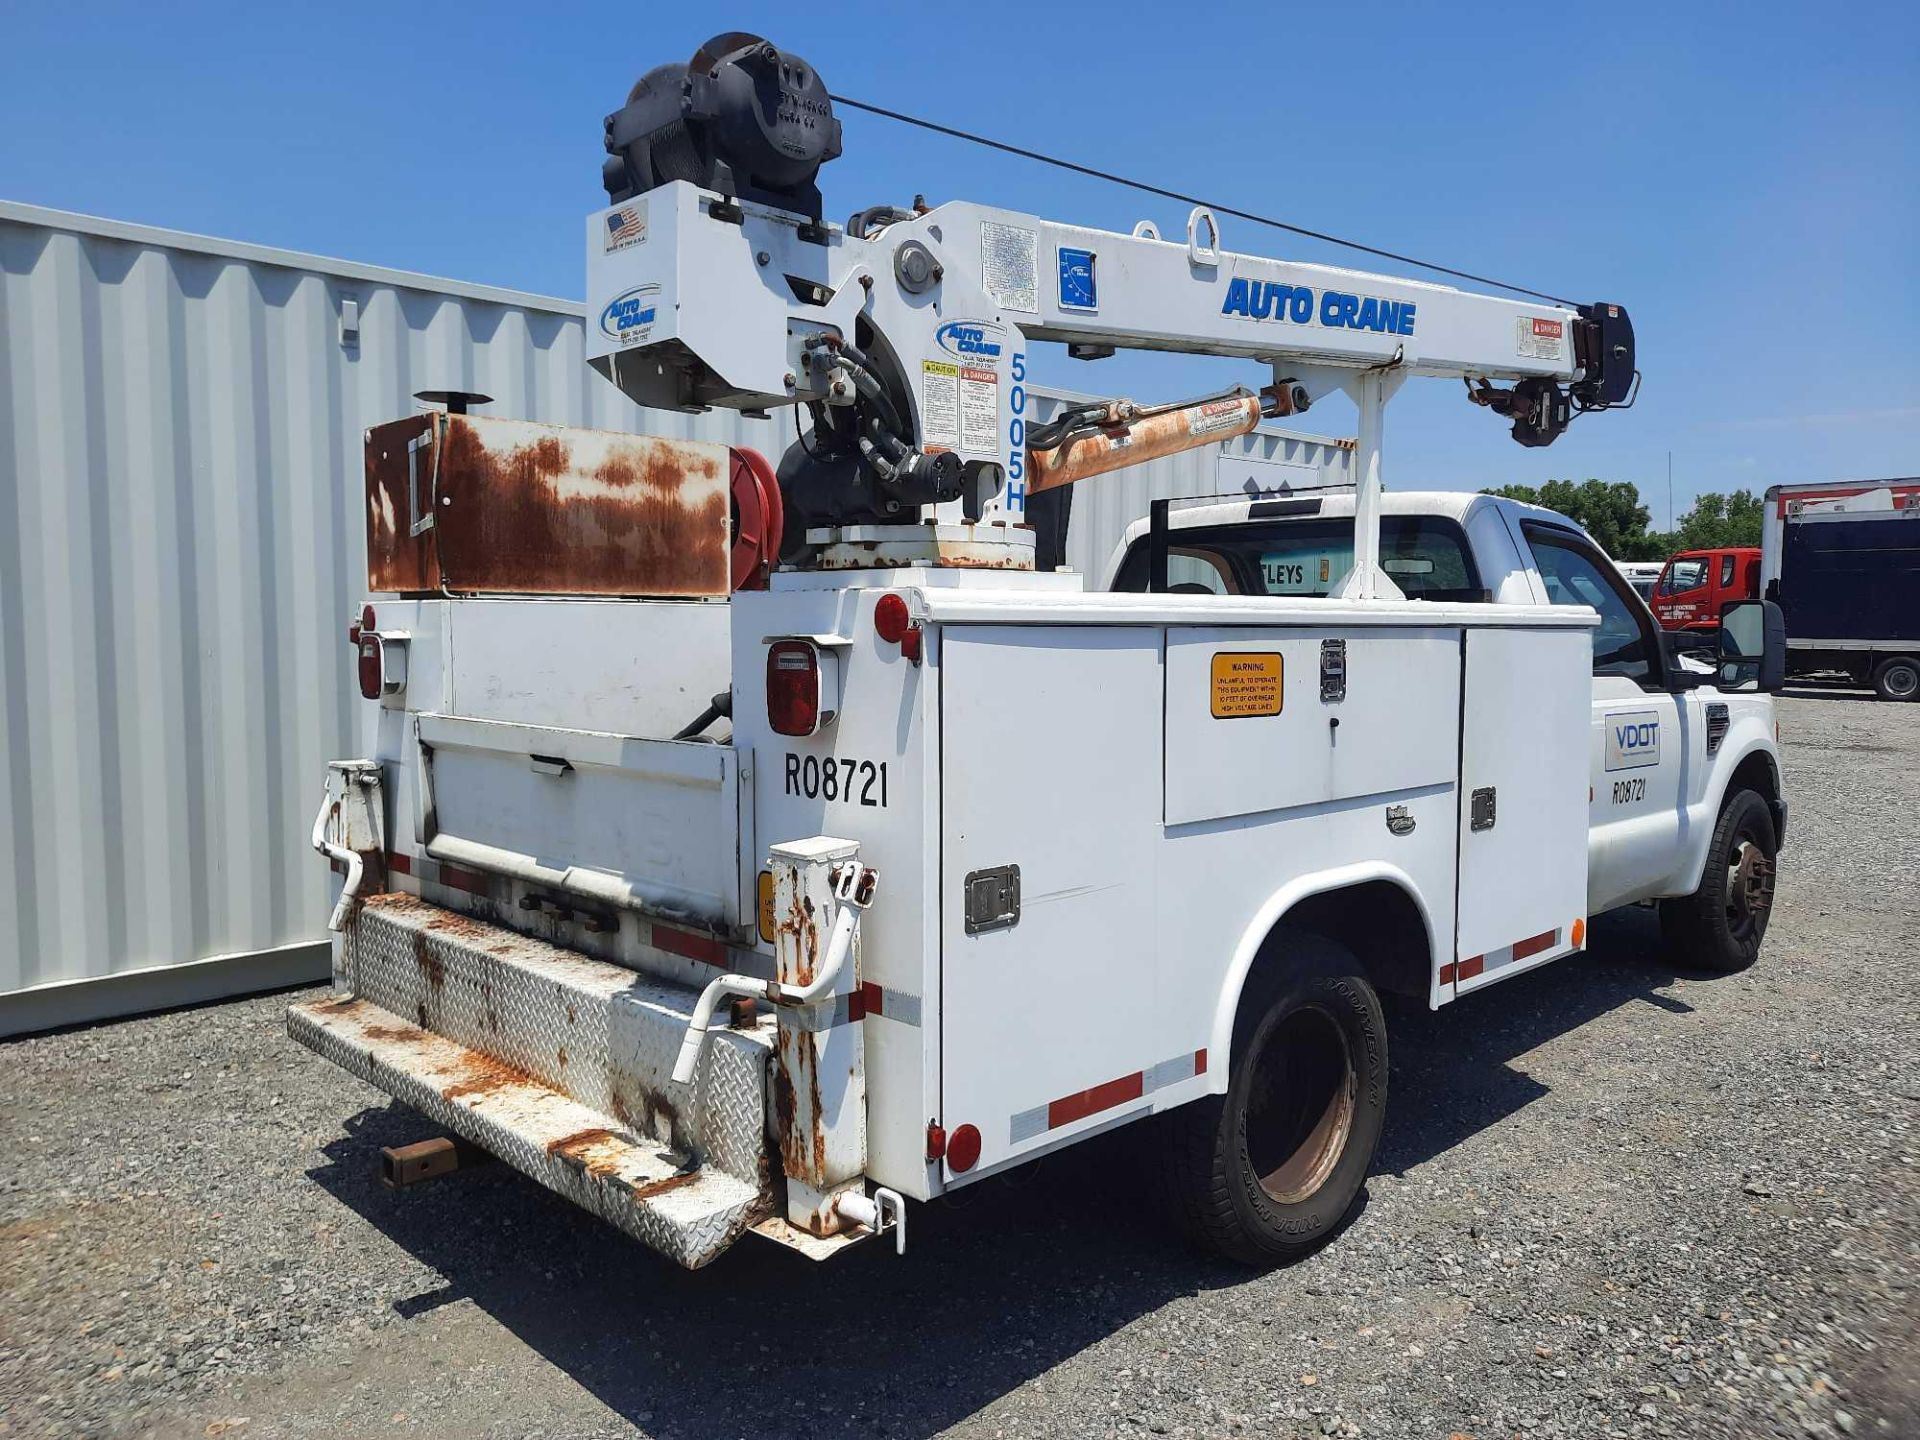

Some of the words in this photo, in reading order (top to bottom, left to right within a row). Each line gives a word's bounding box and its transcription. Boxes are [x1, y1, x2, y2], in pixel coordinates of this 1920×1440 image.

[610, 299, 640, 319] AUTO
[1221, 278, 1313, 324] AUTO
[1320, 291, 1416, 336] CRANE
[617, 308, 655, 331] CRANE
[948, 327, 983, 342] AUTO
[1541, 323, 1561, 334] DANGER
[958, 341, 1001, 356] CRANE
[931, 365, 956, 375] CAUTION
[970, 371, 996, 381] DANGER
[1006, 353, 1026, 511] 5005H
[1232, 663, 1265, 671] WARNING
[1616, 723, 1658, 749] VDOT
